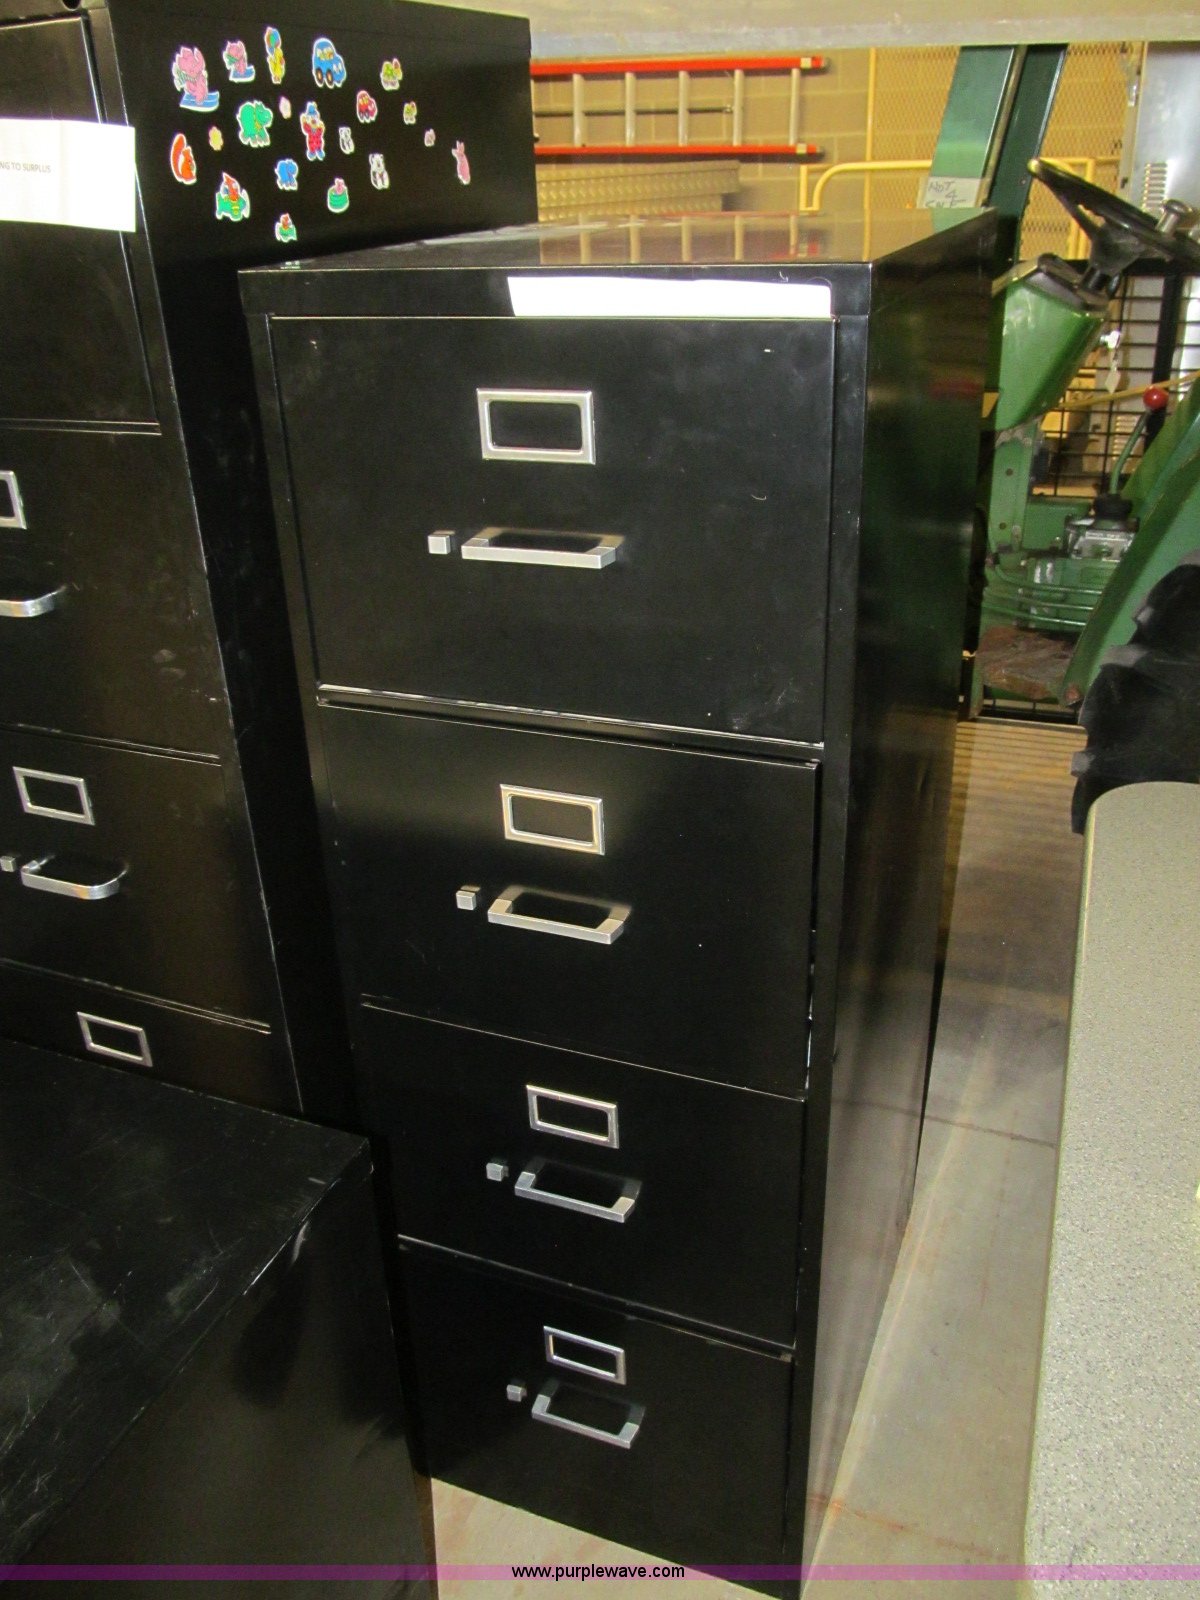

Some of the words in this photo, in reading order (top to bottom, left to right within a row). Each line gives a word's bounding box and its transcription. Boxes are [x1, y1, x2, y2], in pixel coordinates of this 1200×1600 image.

[12, 162, 22, 171] TO
[22, 163, 52, 173] SURPLUS
[927, 180, 955, 193] NOT
